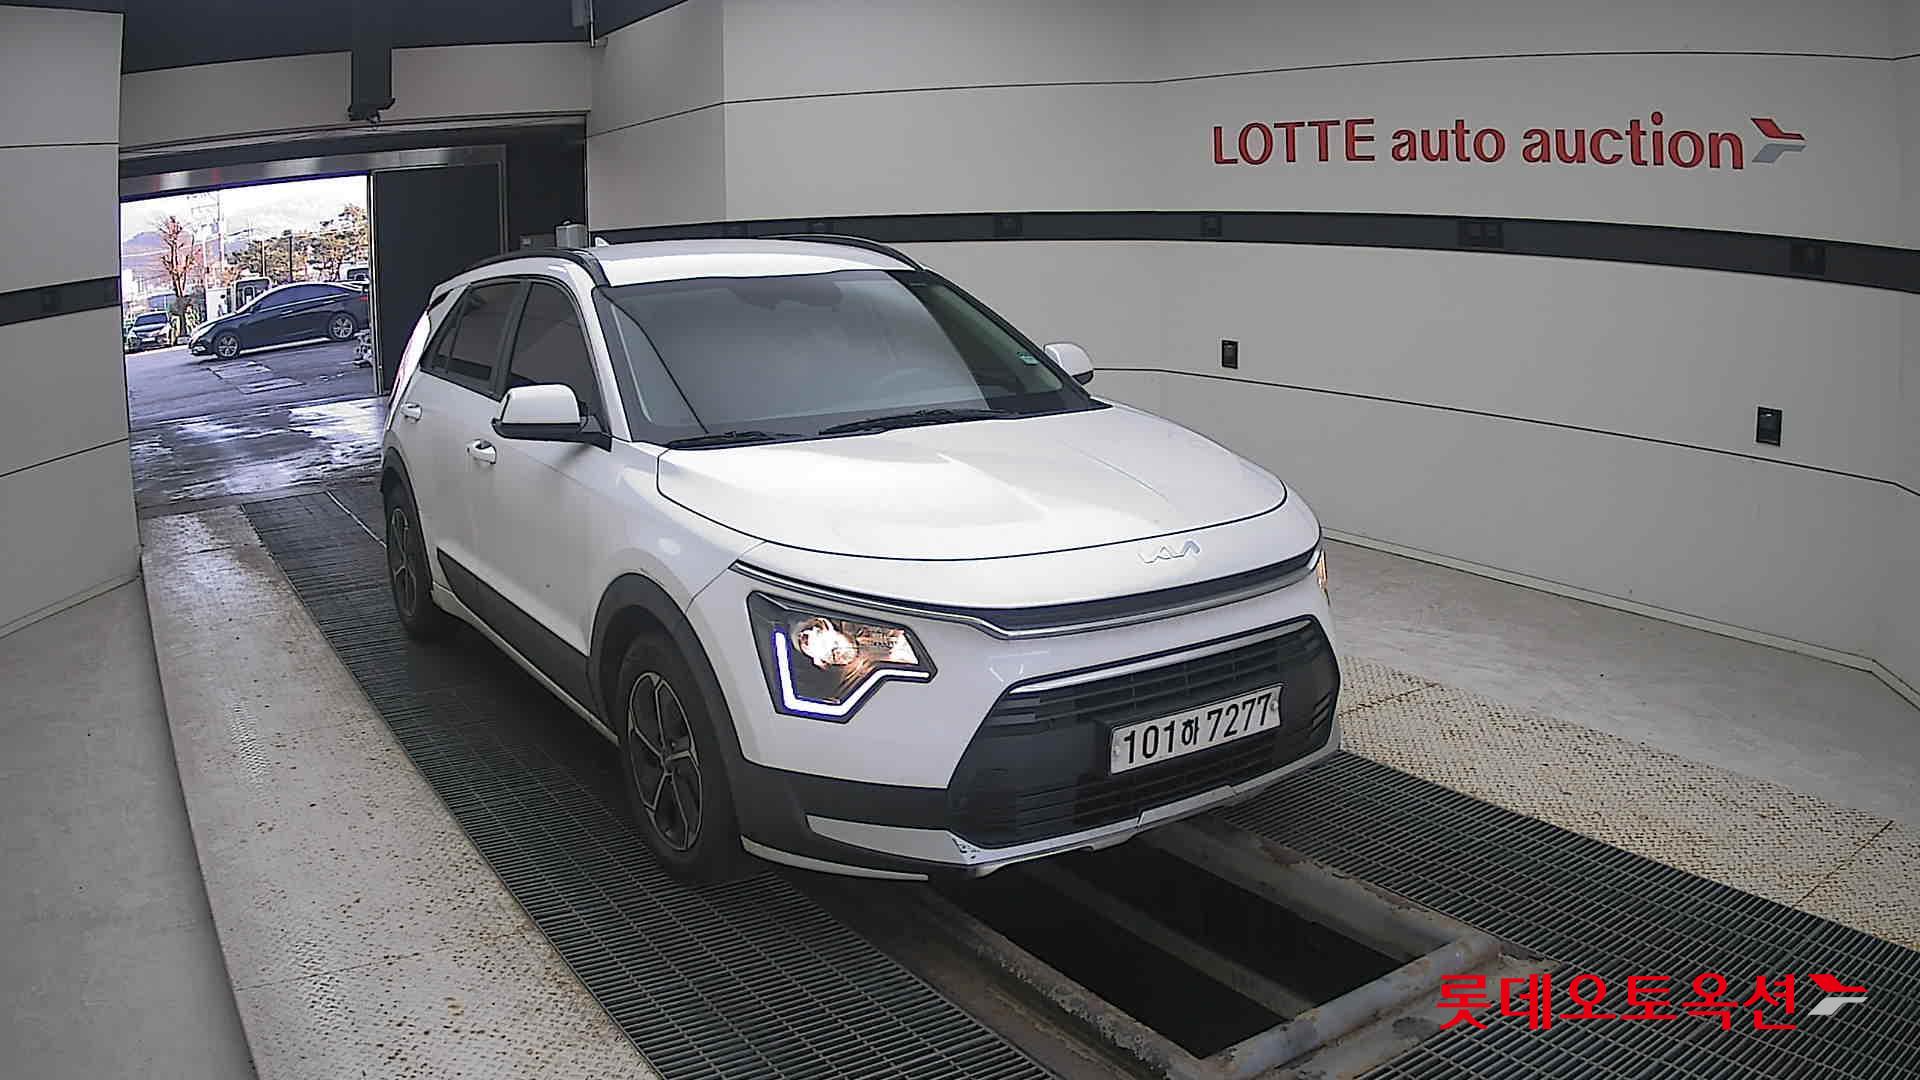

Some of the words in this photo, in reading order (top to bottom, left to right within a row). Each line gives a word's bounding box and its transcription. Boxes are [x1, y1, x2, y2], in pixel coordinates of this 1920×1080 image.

[1213, 118, 1376, 165] LOTTE
[1391, 119, 1506, 162] auto
[1521, 111, 1745, 170] auction
[1123, 715, 1200, 765] 101하
[1206, 692, 1273, 742] 7277
